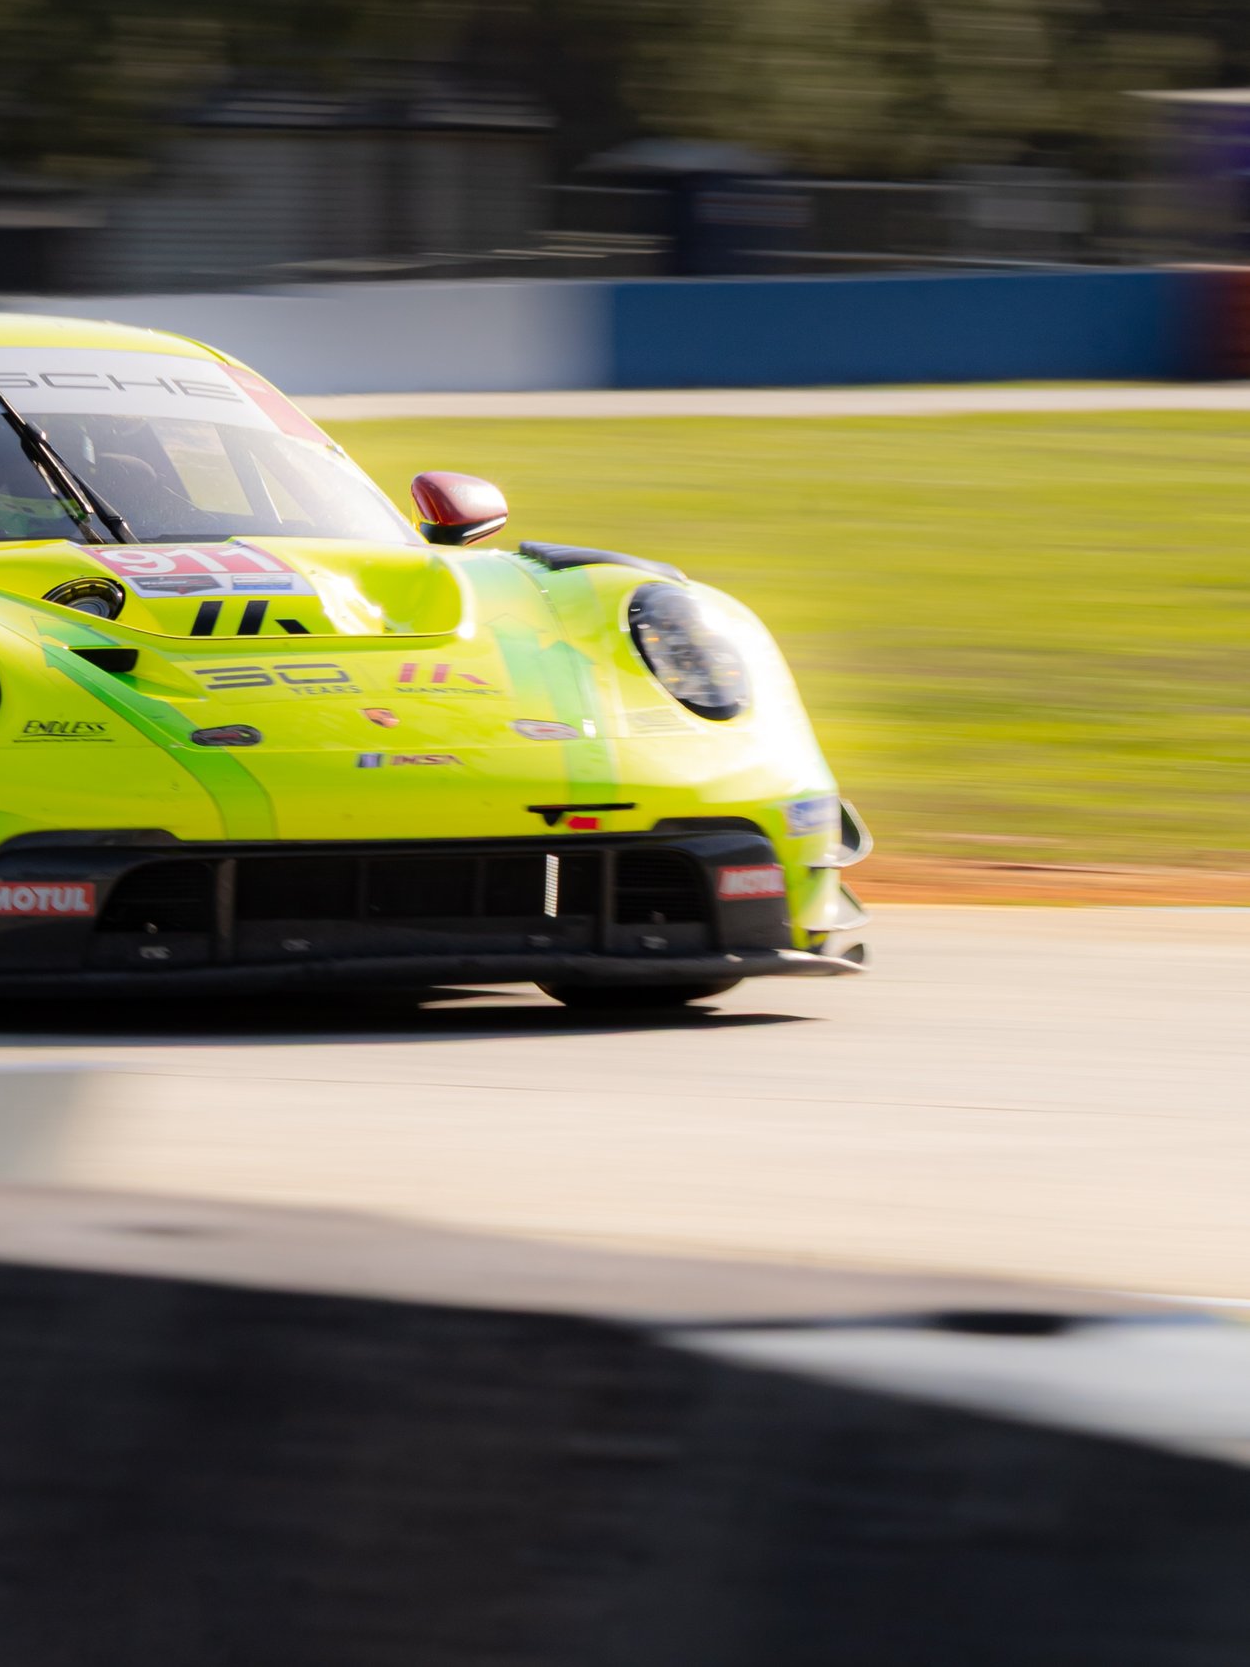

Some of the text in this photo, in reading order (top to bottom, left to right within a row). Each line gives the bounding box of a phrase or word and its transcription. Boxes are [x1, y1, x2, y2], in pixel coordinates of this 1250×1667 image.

[100, 547, 285, 574] 911
[289, 685, 363, 696] YEARS
[22, 719, 110, 735] ENDLESS
